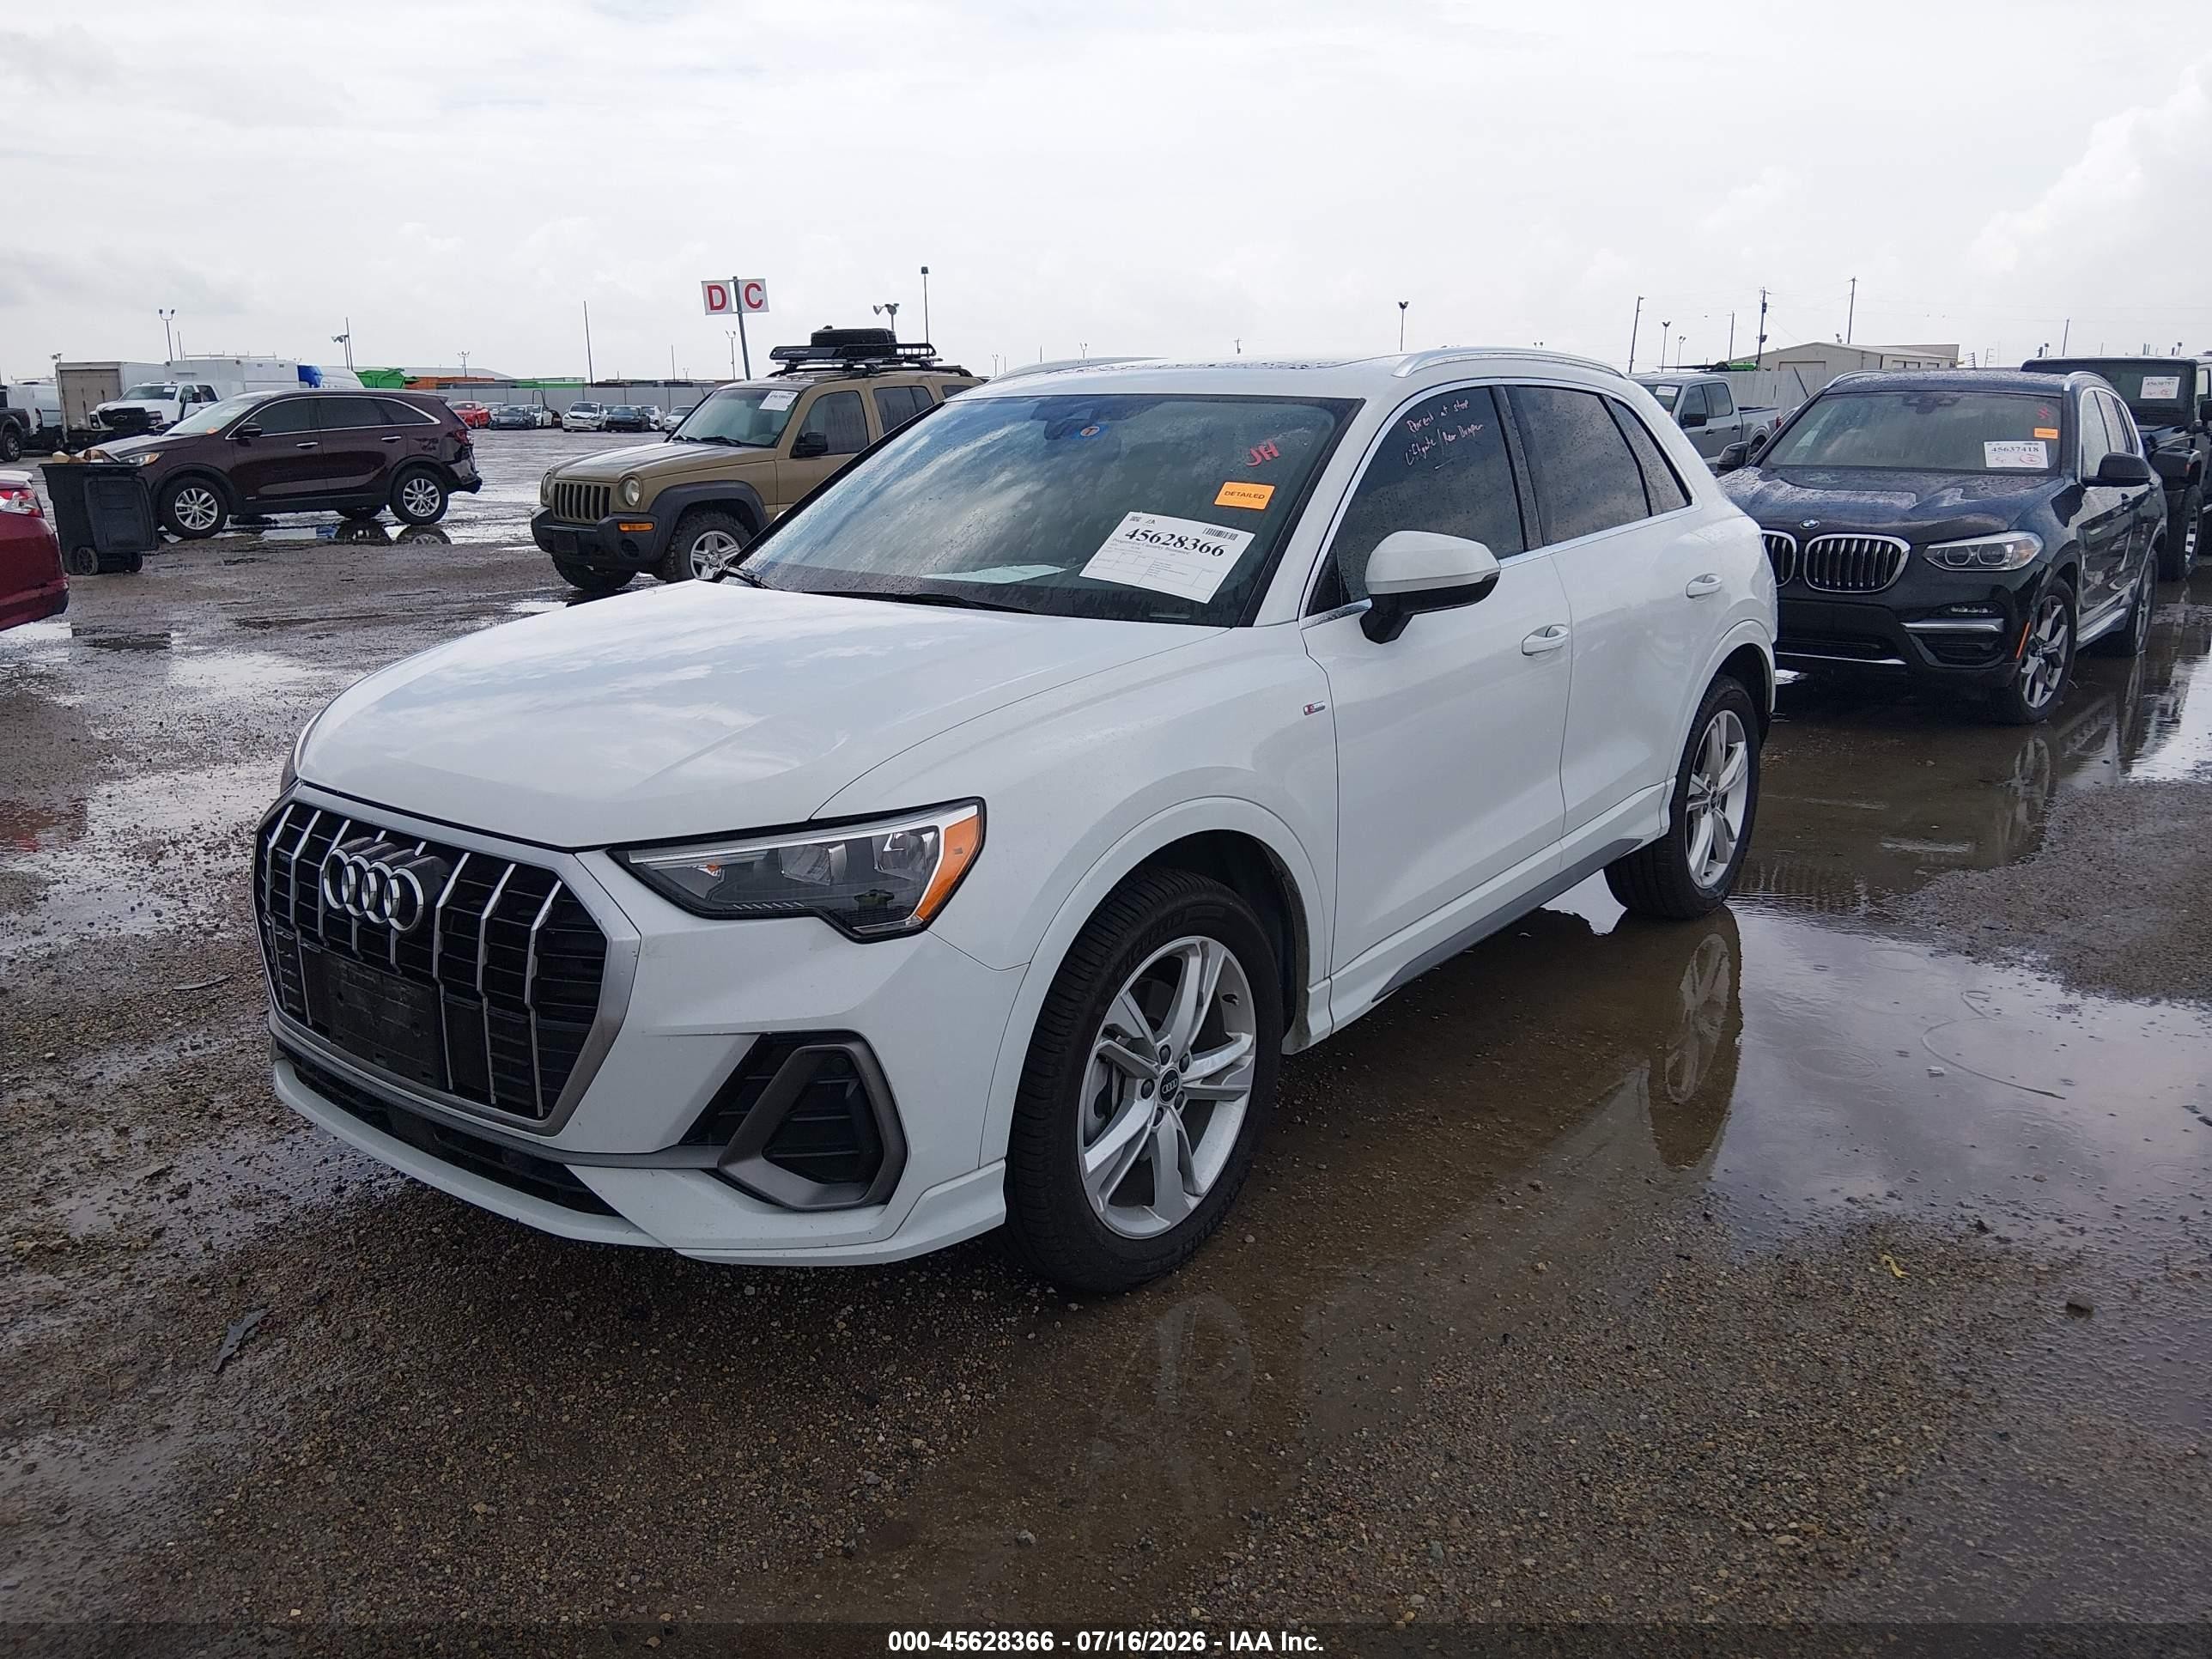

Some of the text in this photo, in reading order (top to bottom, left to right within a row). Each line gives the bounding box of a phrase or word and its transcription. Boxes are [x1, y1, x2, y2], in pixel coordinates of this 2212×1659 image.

[707, 283, 727, 312] D
[744, 282, 764, 310] C
[1224, 489, 1266, 501] DETAILED
[1124, 527, 1231, 557] 45628366
